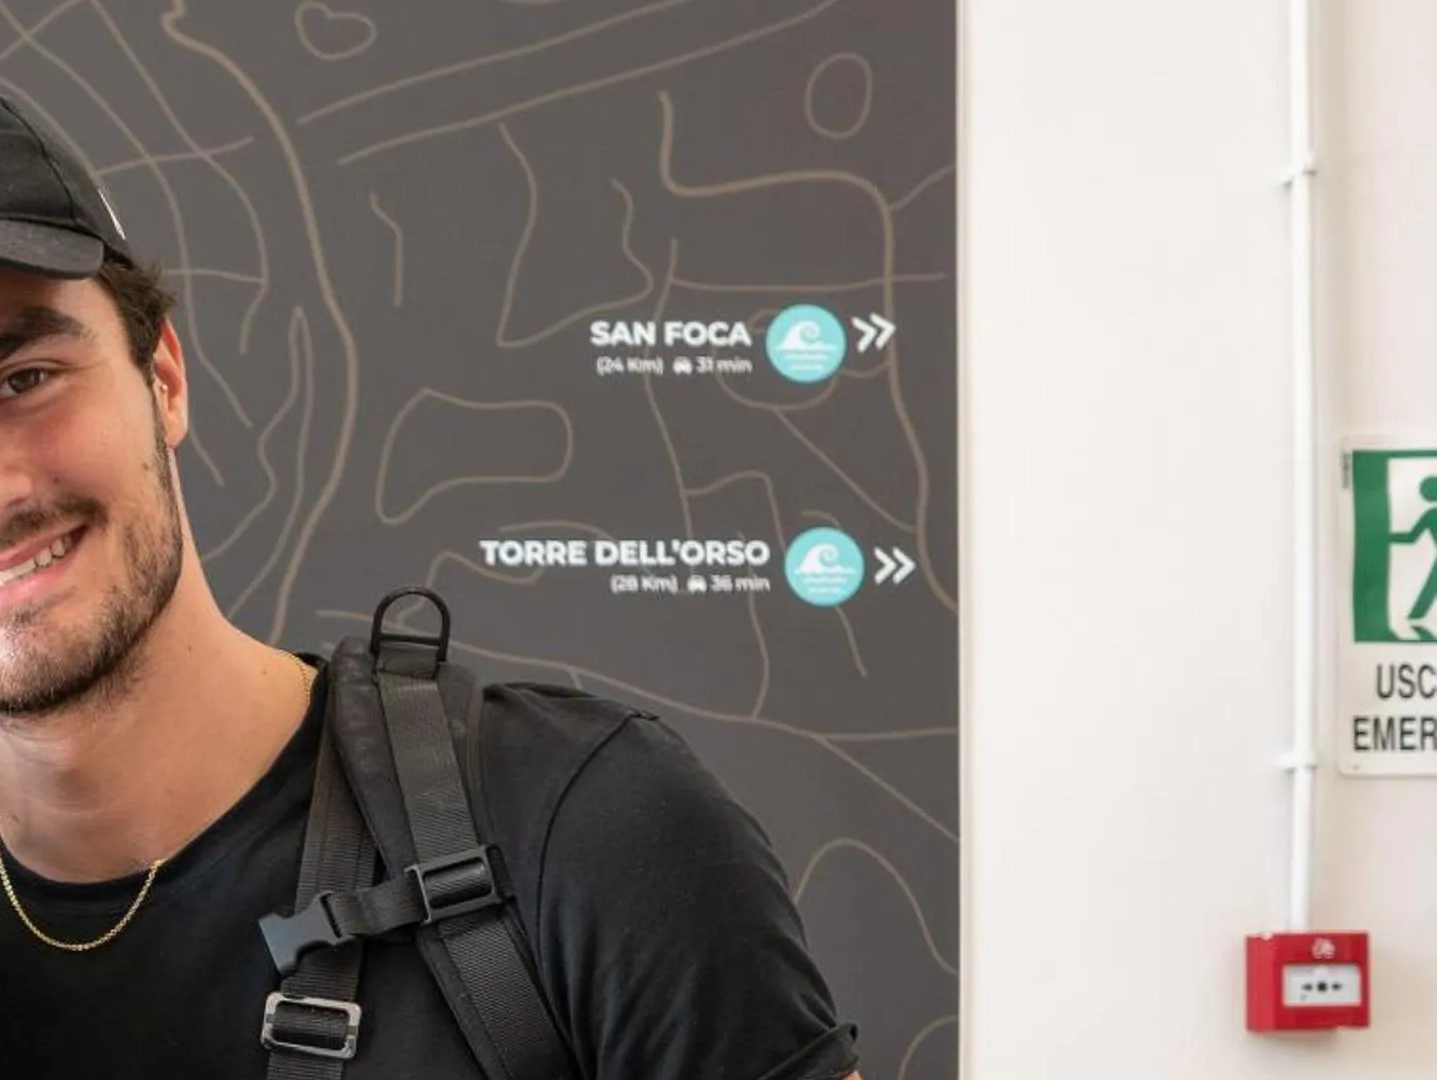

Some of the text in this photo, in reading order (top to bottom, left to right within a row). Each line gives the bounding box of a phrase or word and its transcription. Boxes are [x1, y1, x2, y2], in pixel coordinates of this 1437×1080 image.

[590, 321, 751, 346] SAN FOCA
[716, 356, 753, 374] min
[479, 539, 770, 565] TORRE DELL'ORSO
[736, 575, 770, 591] min
[1376, 663, 1437, 700] USC
[1352, 716, 1437, 752] EMER
